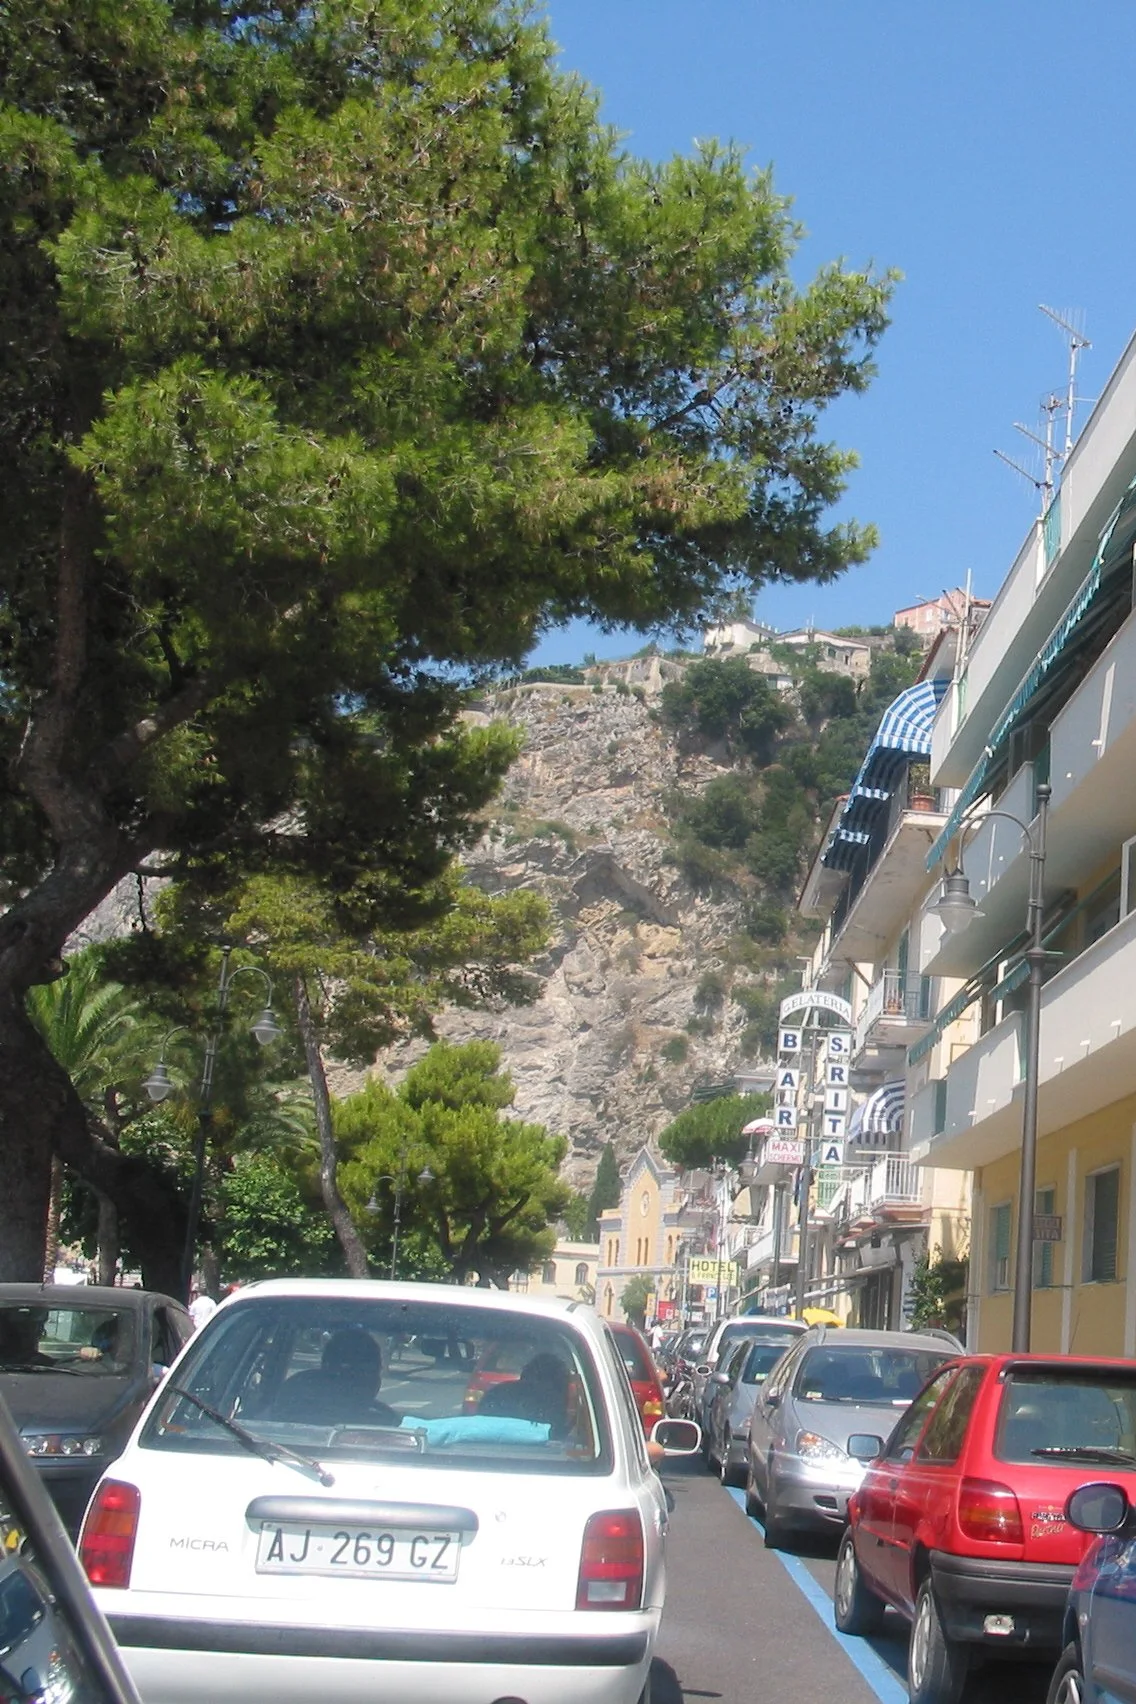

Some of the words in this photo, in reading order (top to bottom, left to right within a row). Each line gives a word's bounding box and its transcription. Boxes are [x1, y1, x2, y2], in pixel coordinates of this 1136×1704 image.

[784, 994, 850, 1018] GELATERIA
[778, 1032, 798, 1125] BAR
[772, 1142, 801, 1152] MAXI
[692, 1260, 735, 1272] HOTEL
[708, 1288, 715, 1297] P
[169, 1536, 229, 1552] MICRA
[266, 1527, 311, 1563] AJ
[330, 1530, 396, 1567] 269
[410, 1535, 452, 1570] GZ
